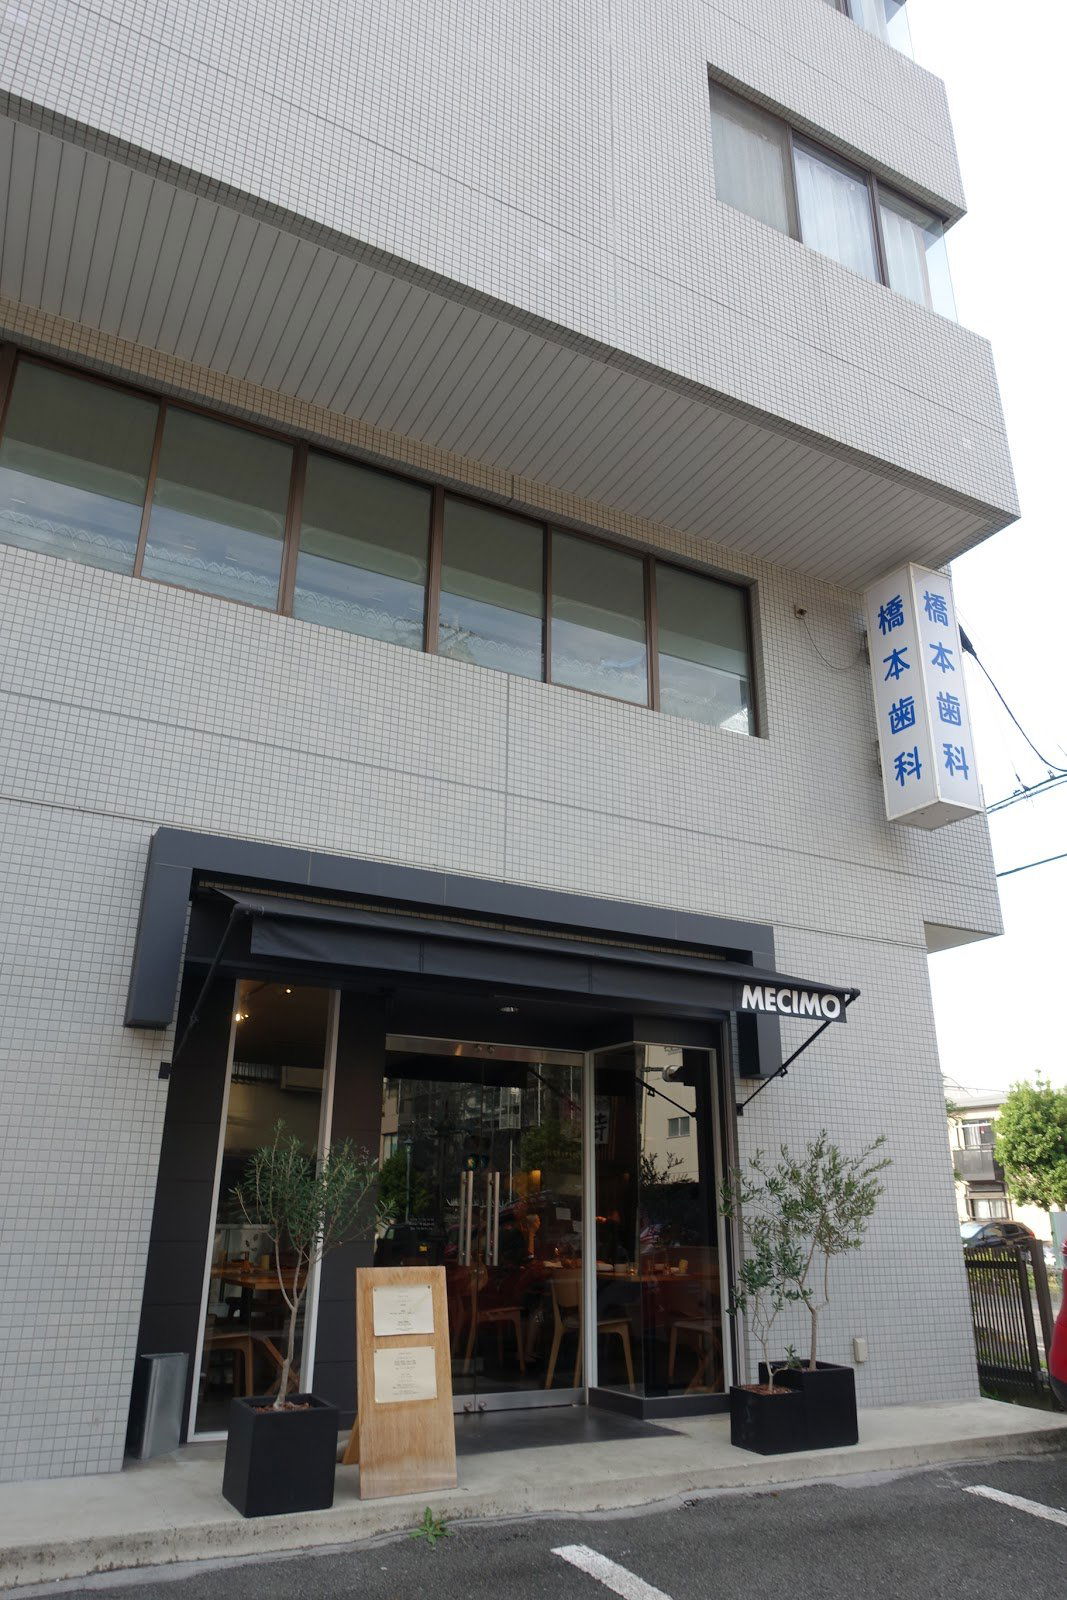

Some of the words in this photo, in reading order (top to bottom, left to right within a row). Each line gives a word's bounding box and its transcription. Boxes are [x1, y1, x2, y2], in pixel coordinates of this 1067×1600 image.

[878, 594, 922, 786] 橋本歯科
[923, 590, 969, 781] 橋本歯科
[741, 984, 841, 1019] MECIMO
